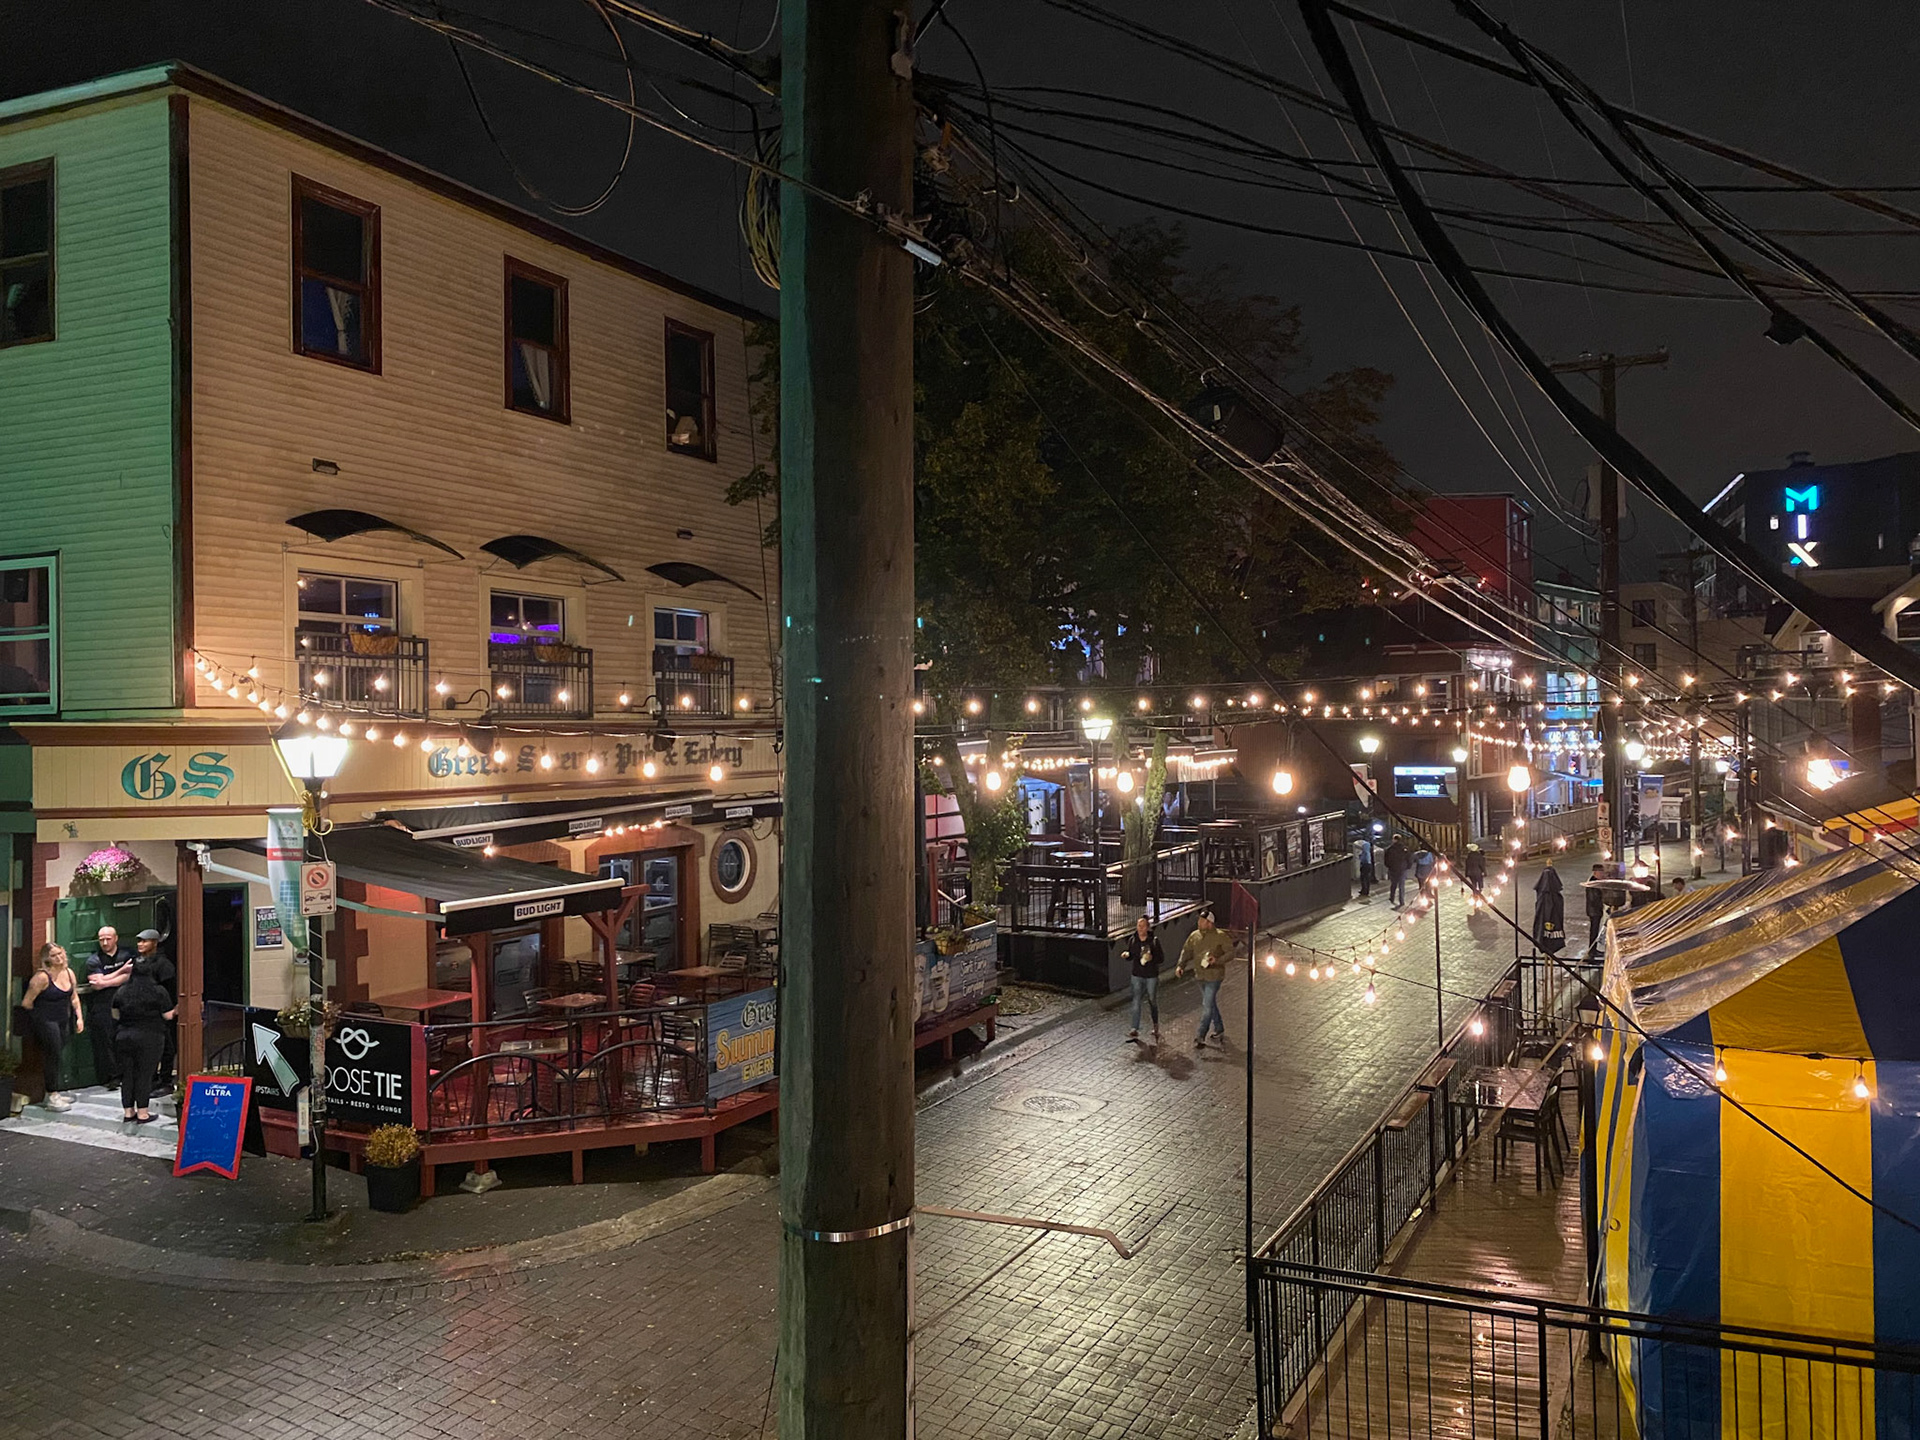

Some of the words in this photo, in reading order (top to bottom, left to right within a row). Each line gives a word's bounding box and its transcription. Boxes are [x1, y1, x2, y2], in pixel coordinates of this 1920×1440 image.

[1785, 485, 1819, 568] MIX
[428, 746, 508, 778] Gree
[570, 822, 583, 830] BUD
[583, 820, 601, 828] LIGHT
[456, 838, 471, 846] BUD
[471, 835, 491, 845] LIGHT
[516, 906, 536, 917] BUD
[537, 901, 562, 914] LIGHT
[741, 1000, 777, 1029] Gree
[716, 1027, 775, 1072] Summ
[373, 1072, 402, 1101] TIE
[327, 1097, 345, 1105] TAILS
[350, 1100, 369, 1109] RESTO
[377, 1105, 402, 1114] LOUNGE
